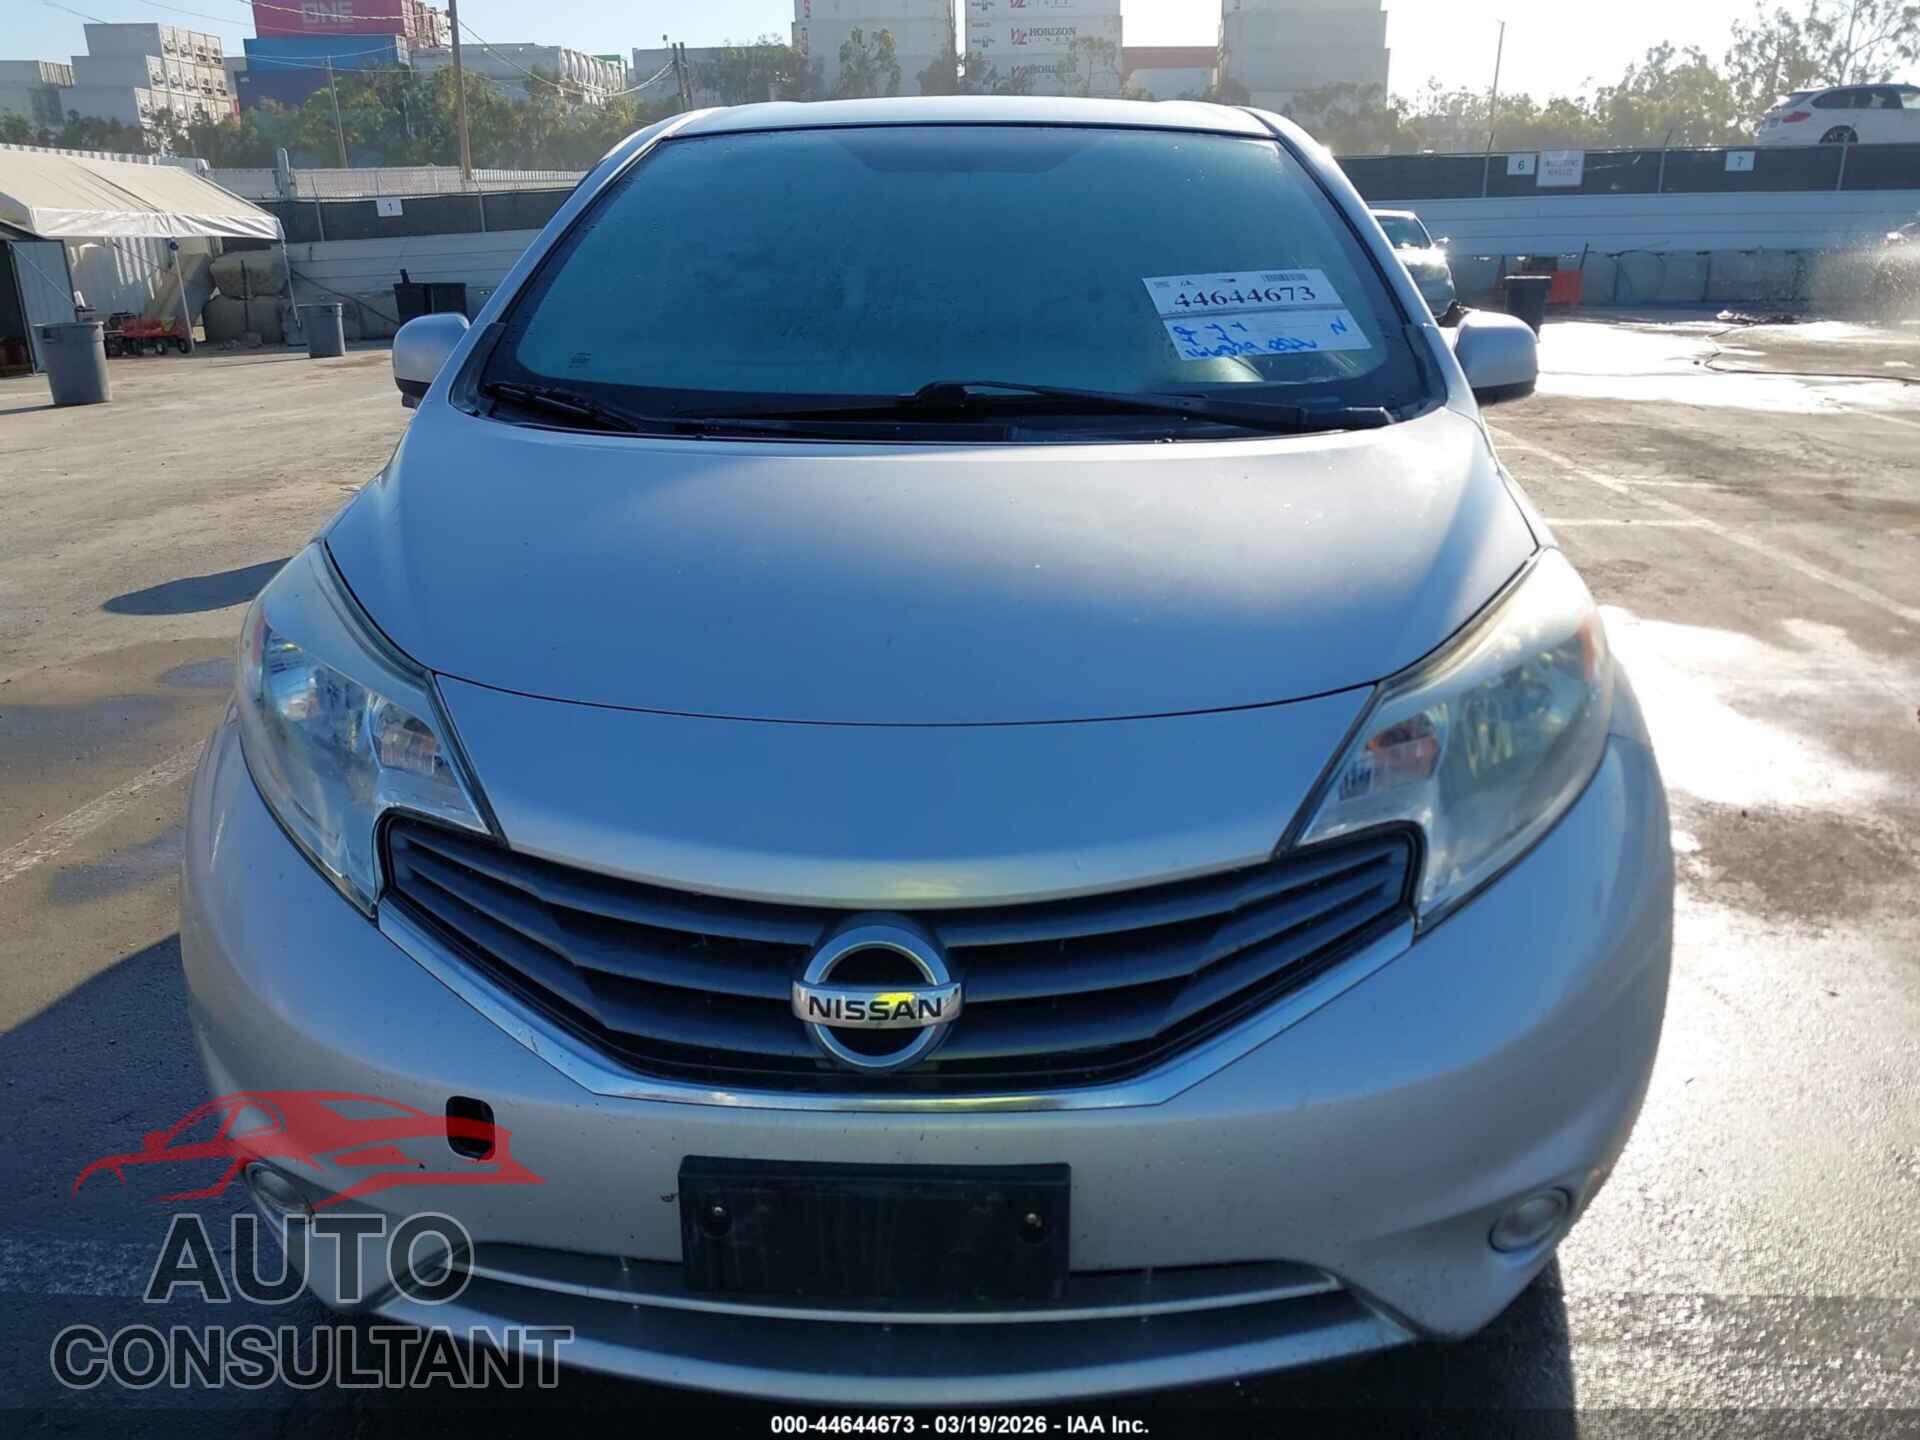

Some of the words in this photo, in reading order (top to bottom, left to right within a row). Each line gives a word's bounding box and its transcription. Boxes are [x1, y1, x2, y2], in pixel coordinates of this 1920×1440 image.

[301, 1, 353, 24] ONE
[1029, 26, 1077, 37] HORIZON
[1518, 159, 1525, 170] 6
[1736, 155, 1744, 168] 7
[1174, 286, 1316, 308] 44644673
[808, 995, 943, 1021] NISSAN
